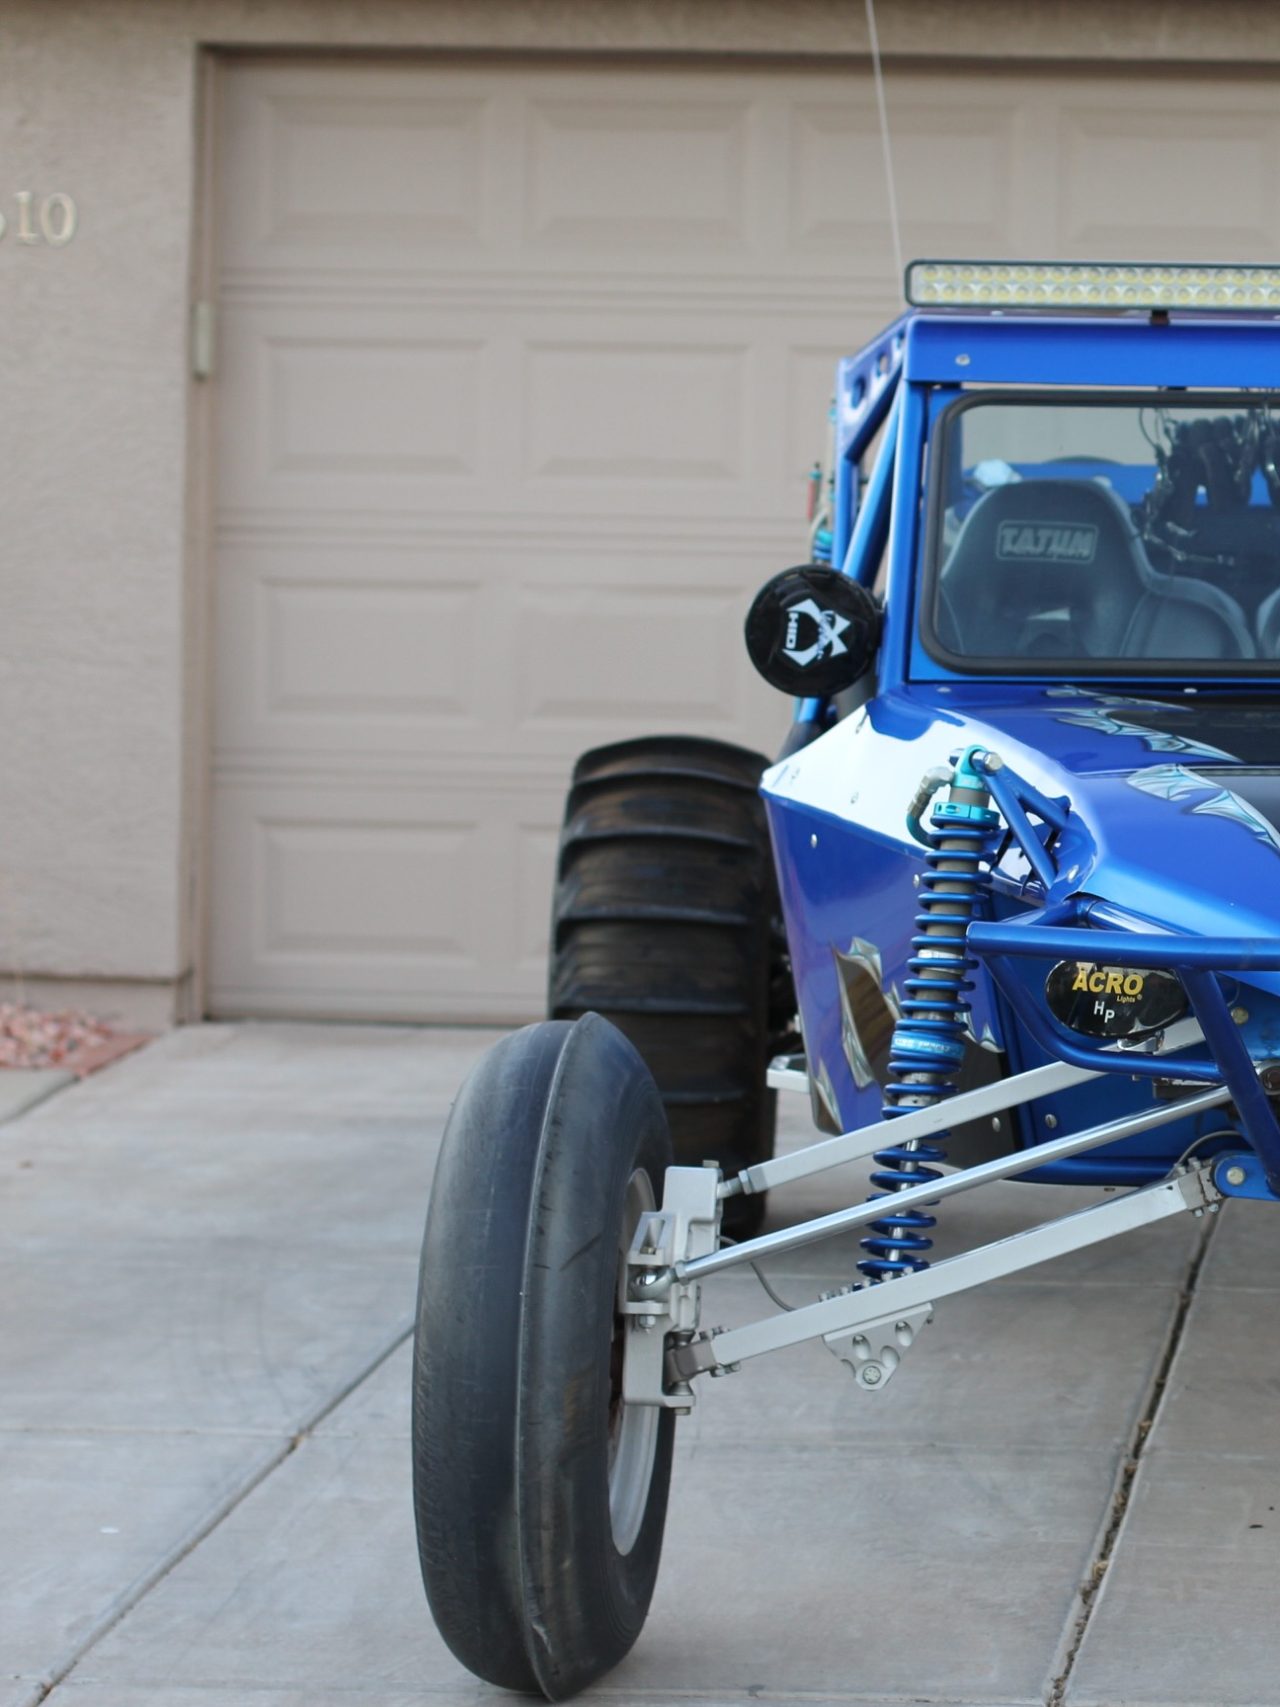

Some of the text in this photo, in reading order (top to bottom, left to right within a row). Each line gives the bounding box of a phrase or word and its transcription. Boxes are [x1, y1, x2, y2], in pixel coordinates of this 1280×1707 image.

[0, 191, 77, 247] 10
[1002, 527, 1093, 557] TATUM
[1072, 969, 1144, 995] ACRO
